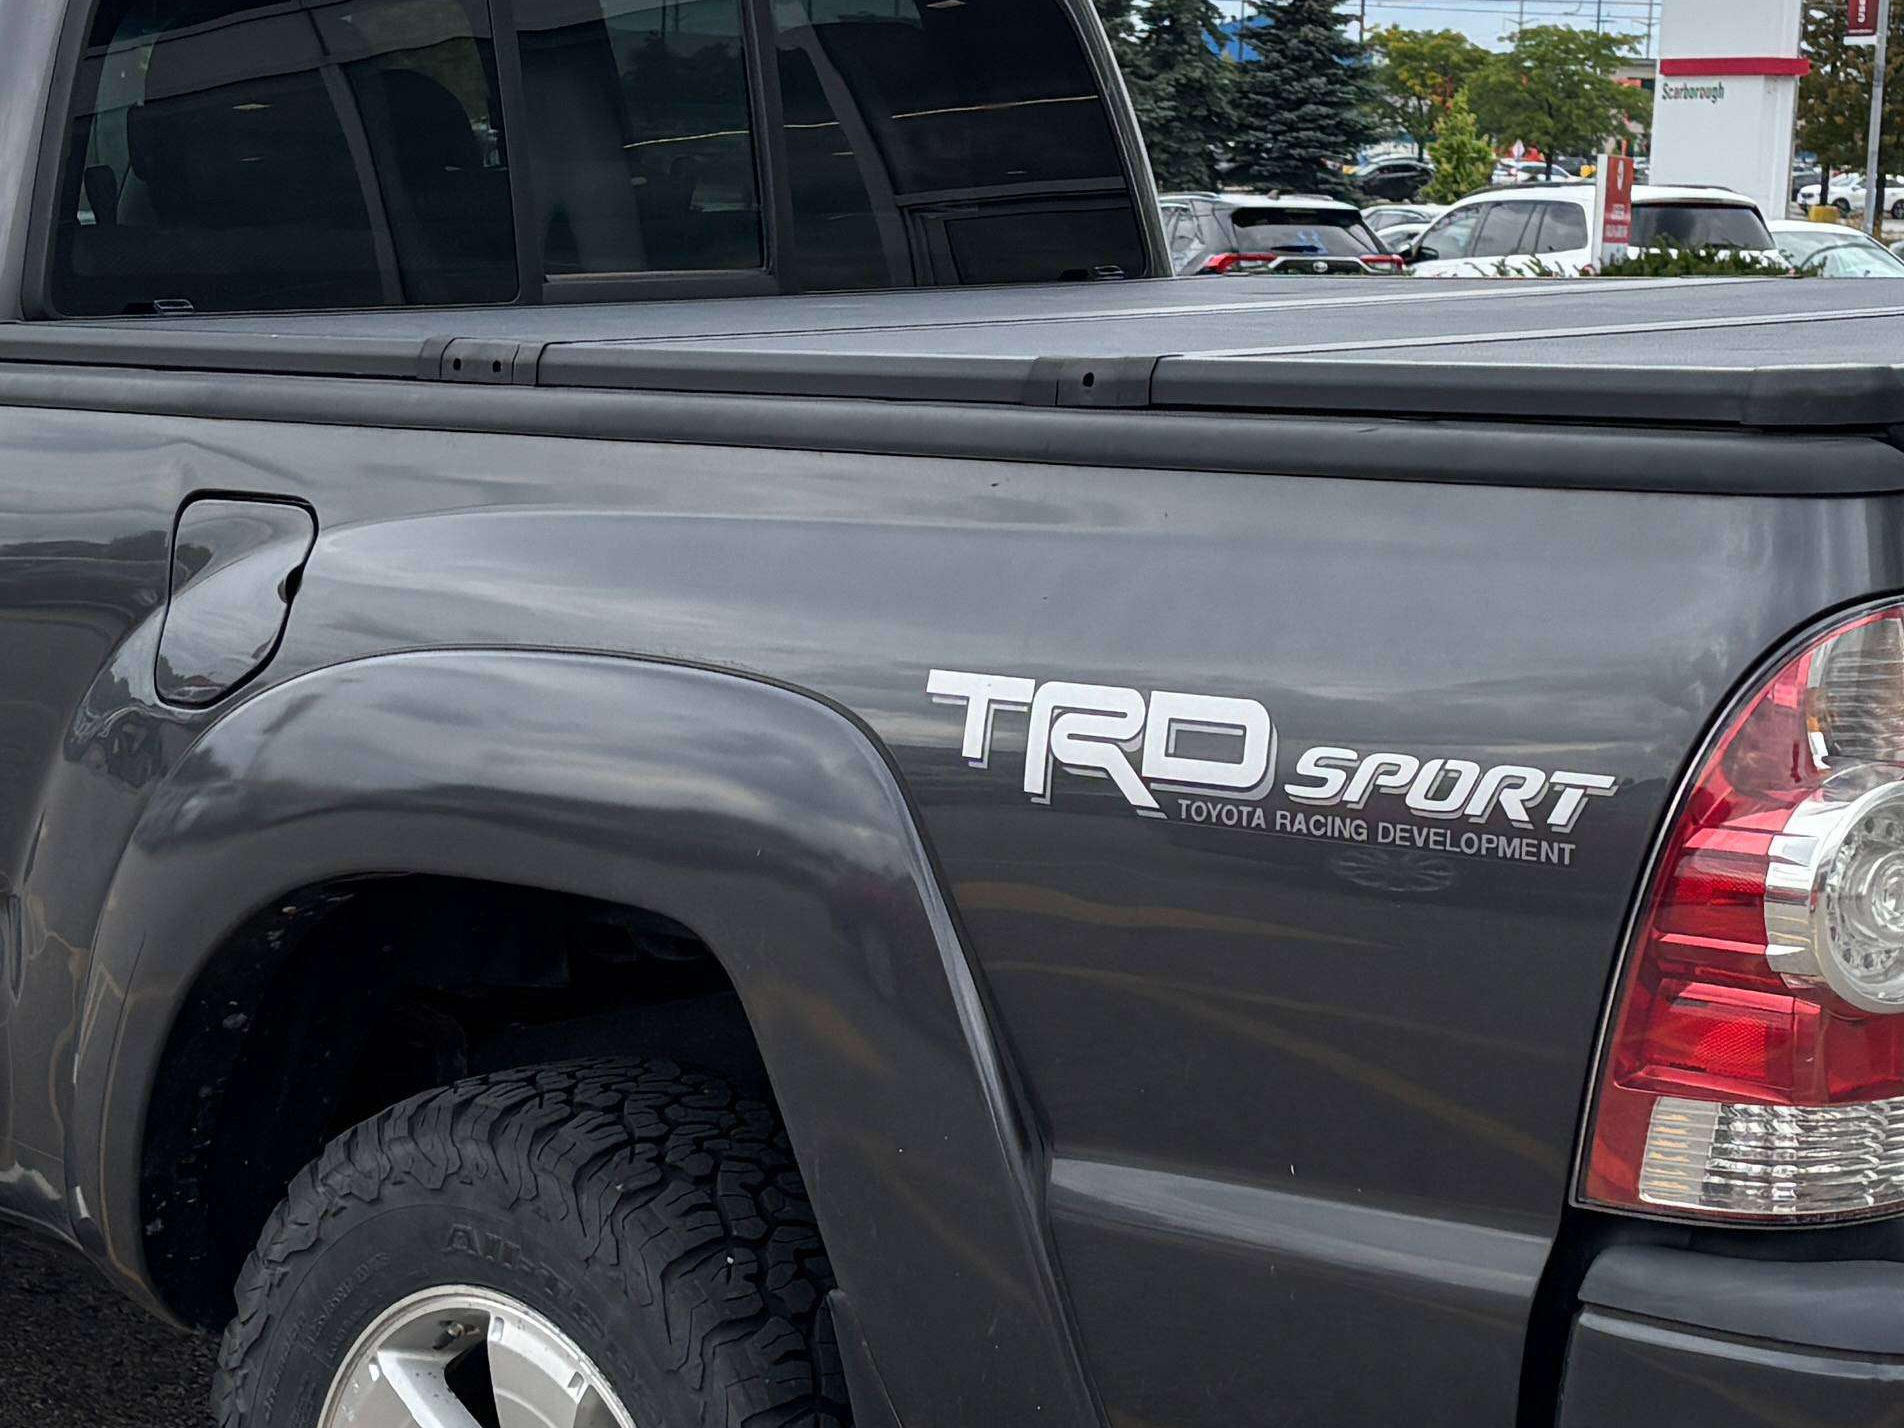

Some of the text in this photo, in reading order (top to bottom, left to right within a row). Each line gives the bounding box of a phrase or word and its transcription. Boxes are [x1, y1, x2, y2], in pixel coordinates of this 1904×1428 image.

[1661, 82, 1725, 104] Scarborough
[925, 668, 1619, 834] TRD SPORT
[1177, 798, 1576, 866] TOYOTA RACING DEVELOPMENT
